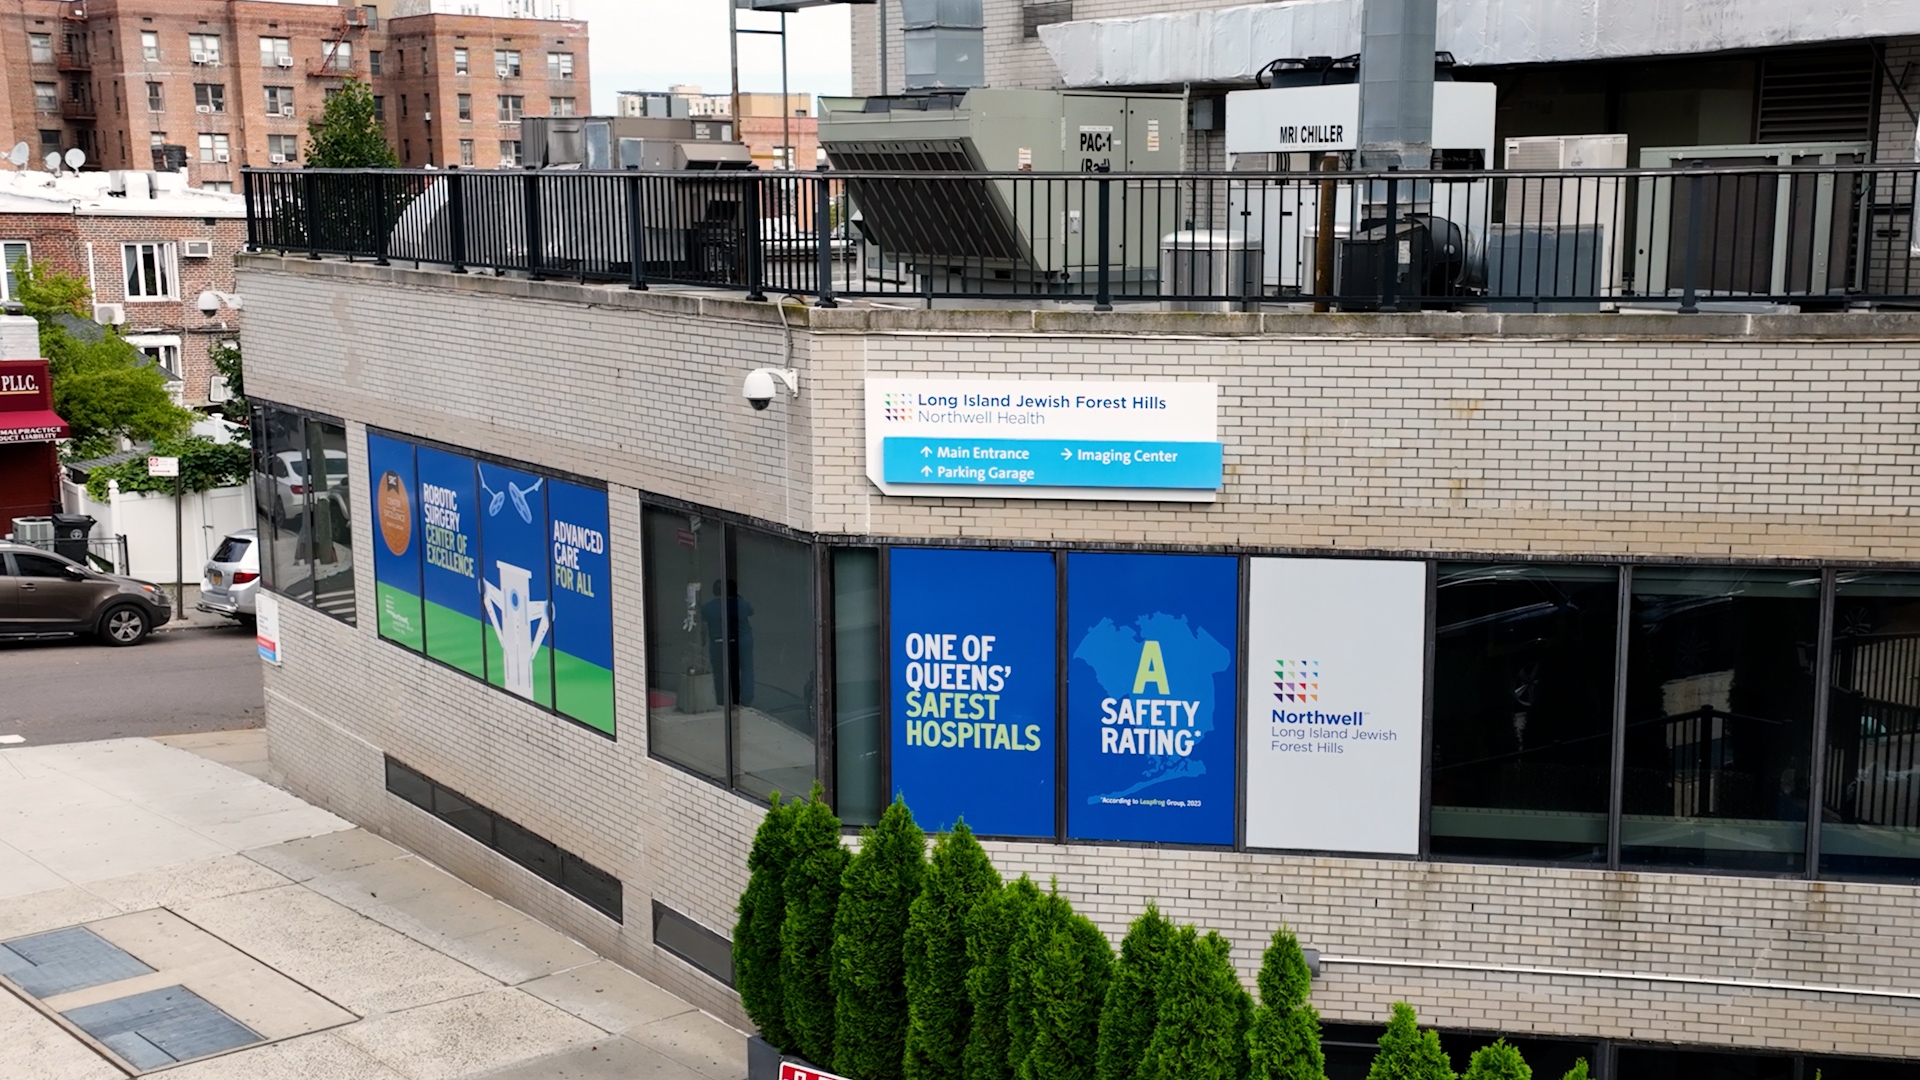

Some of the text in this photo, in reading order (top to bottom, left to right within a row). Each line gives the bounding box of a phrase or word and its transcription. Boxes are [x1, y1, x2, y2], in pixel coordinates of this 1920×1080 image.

[1080, 133, 1111, 152] PAC-1
[1280, 125, 1343, 144] MRI CHILLER
[1, 374, 39, 391] PLLC.
[918, 394, 1166, 409] Long Island Jewish Forest Hills
[918, 410, 1045, 424] Northwell Health
[0, 426, 61, 435] MALPRACTICE
[937, 446, 1030, 460] Main Entrance
[1077, 449, 1178, 465] Imaging Center
[937, 466, 1035, 483] Parking Garage
[423, 482, 458, 511] ROBOTIC
[424, 503, 461, 533] SURGERY
[425, 523, 468, 555] CENTER OF
[553, 519, 603, 555] ADVANCED
[426, 543, 475, 579] EXCELLENCE
[554, 541, 580, 570] CARE
[554, 563, 595, 598] FOR ALL
[905, 632, 996, 662] ONE OF
[905, 661, 1012, 692] QUEENS'
[1132, 640, 1171, 695] A
[905, 690, 1000, 720] SAFEST
[1101, 697, 1201, 727] SAFETY
[1272, 709, 1363, 726] Northwell
[906, 719, 1041, 751] HOSPITALS
[1271, 726, 1397, 741] Long Island Jewish
[1271, 740, 1344, 754] Forest Hills
[1140, 798, 1165, 807] Leapfrog
